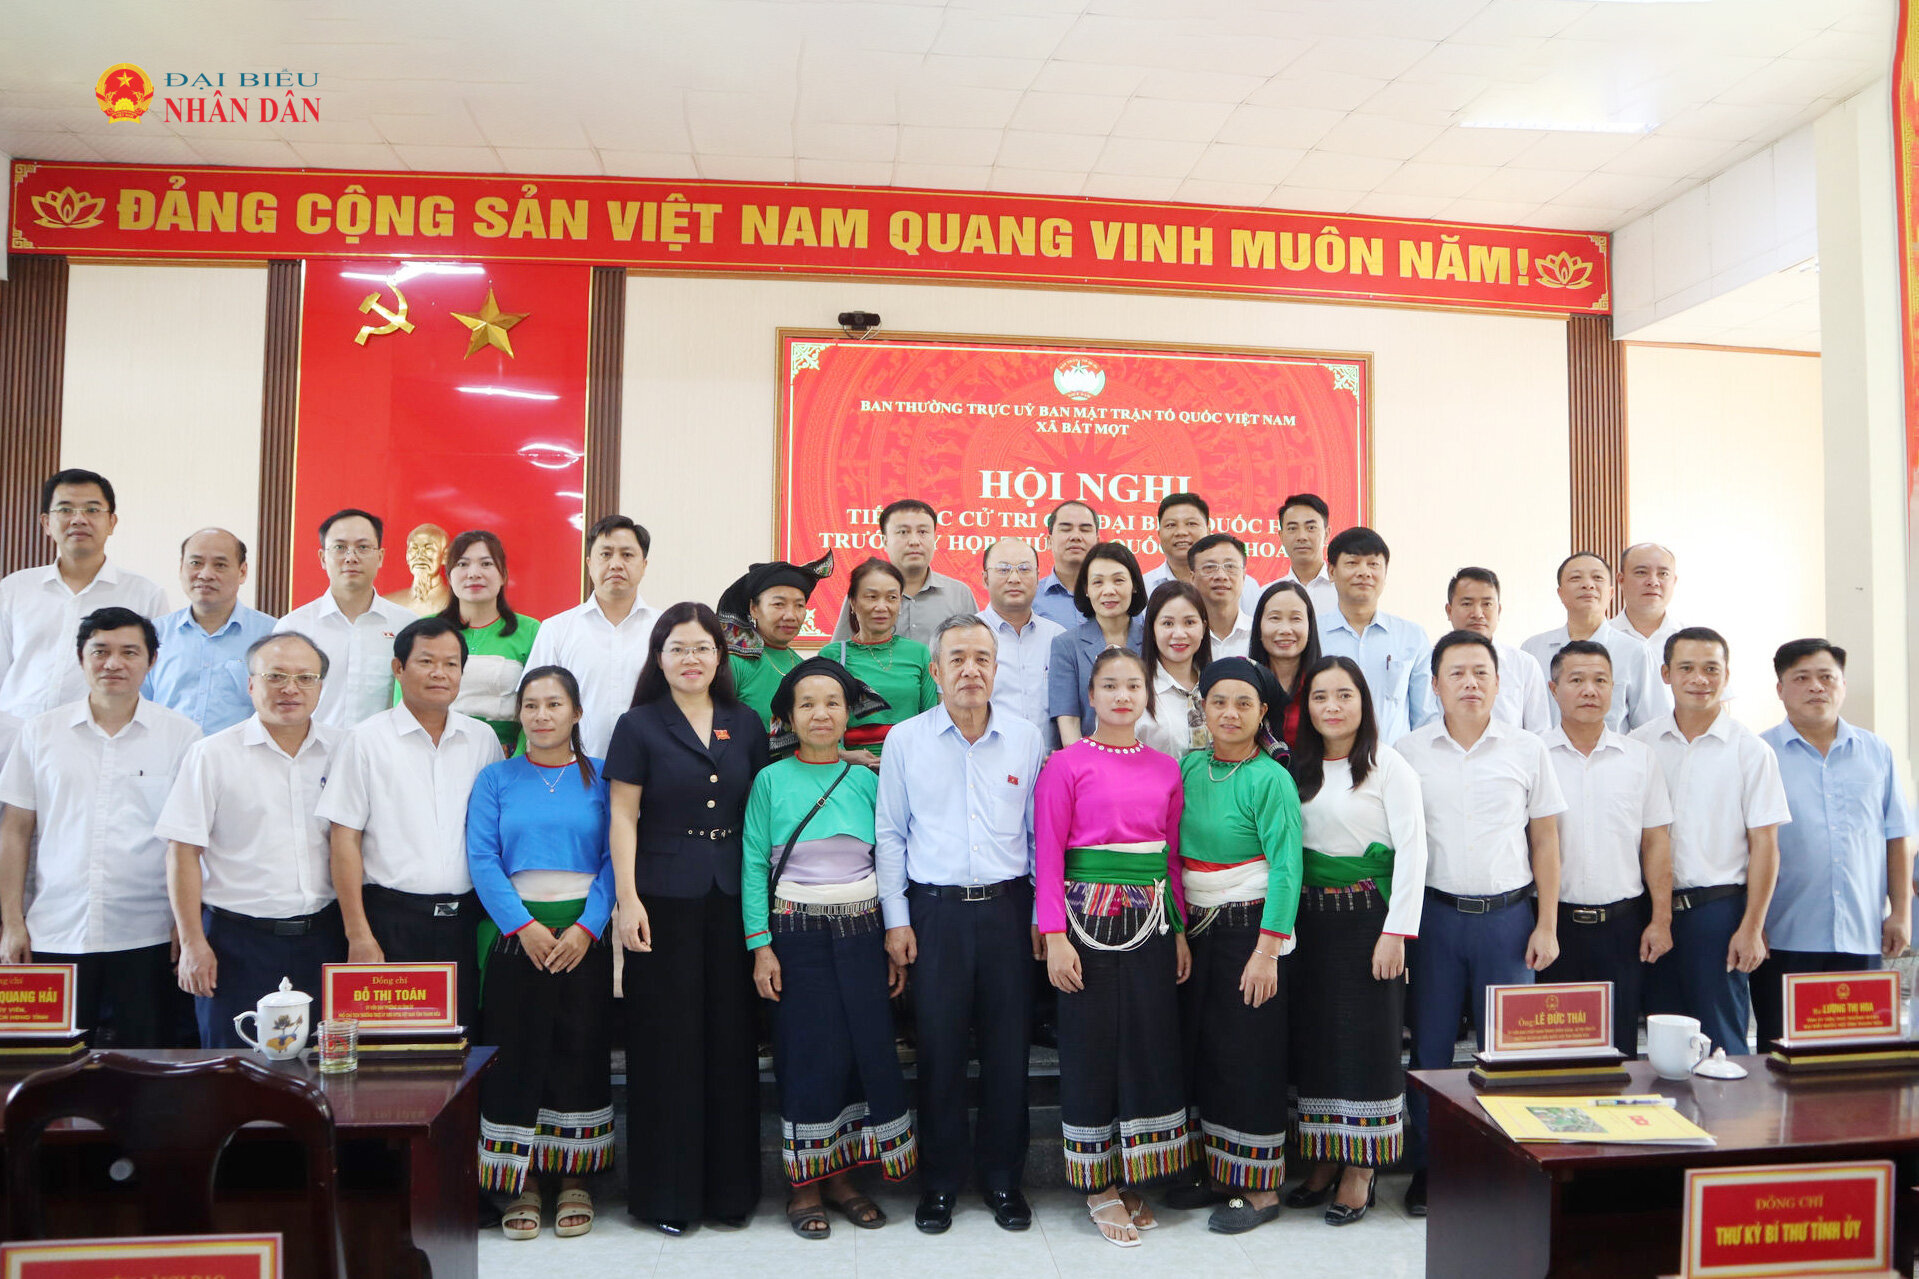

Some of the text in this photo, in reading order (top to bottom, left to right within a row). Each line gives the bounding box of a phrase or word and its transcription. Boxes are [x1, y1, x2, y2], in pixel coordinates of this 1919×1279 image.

[116, 175, 1530, 286] ĐẢNG CỘNG SẢN VIỆT NAM QUANG VINH MUÔN NĂM!
[860, 400, 893, 412] BAN
[895, 399, 963, 414] THƯỜNG
[966, 402, 1011, 418] TRỰC
[1039, 406, 1071, 418] BAN
[1110, 408, 1152, 423] TRẬN
[1178, 409, 1223, 424] QUỐC
[1224, 412, 1260, 427] VIỆT
[1262, 414, 1297, 426] NAM
[1061, 421, 1093, 434] BÁT
[1094, 423, 1130, 437] MỌT
[978, 466, 1065, 508] HỘI
[846, 504, 885, 525] TIẾ
[958, 507, 994, 527] CỬ
[998, 512, 1038, 528] TRI
[818, 529, 885, 549] TRƯỚ
[374, 989, 392, 1004] THỊ
